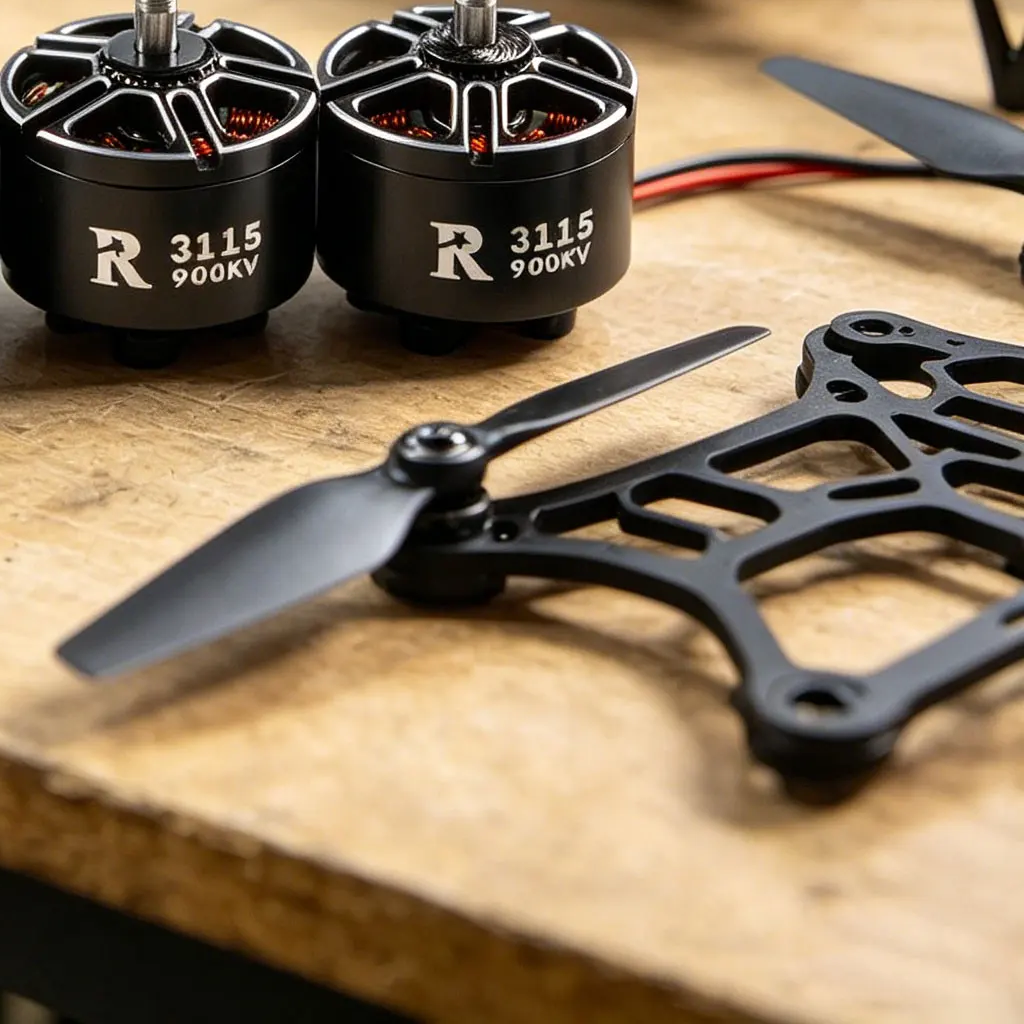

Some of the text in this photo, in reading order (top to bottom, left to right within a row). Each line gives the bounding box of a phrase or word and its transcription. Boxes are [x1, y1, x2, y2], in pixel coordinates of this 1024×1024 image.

[170, 220, 262, 264] 3115
[429, 221, 494, 281] R
[510, 207, 594, 255] 3115
[88, 226, 153, 289] R
[172, 253, 260, 289] 900KV
[510, 241, 592, 279] 900KV
